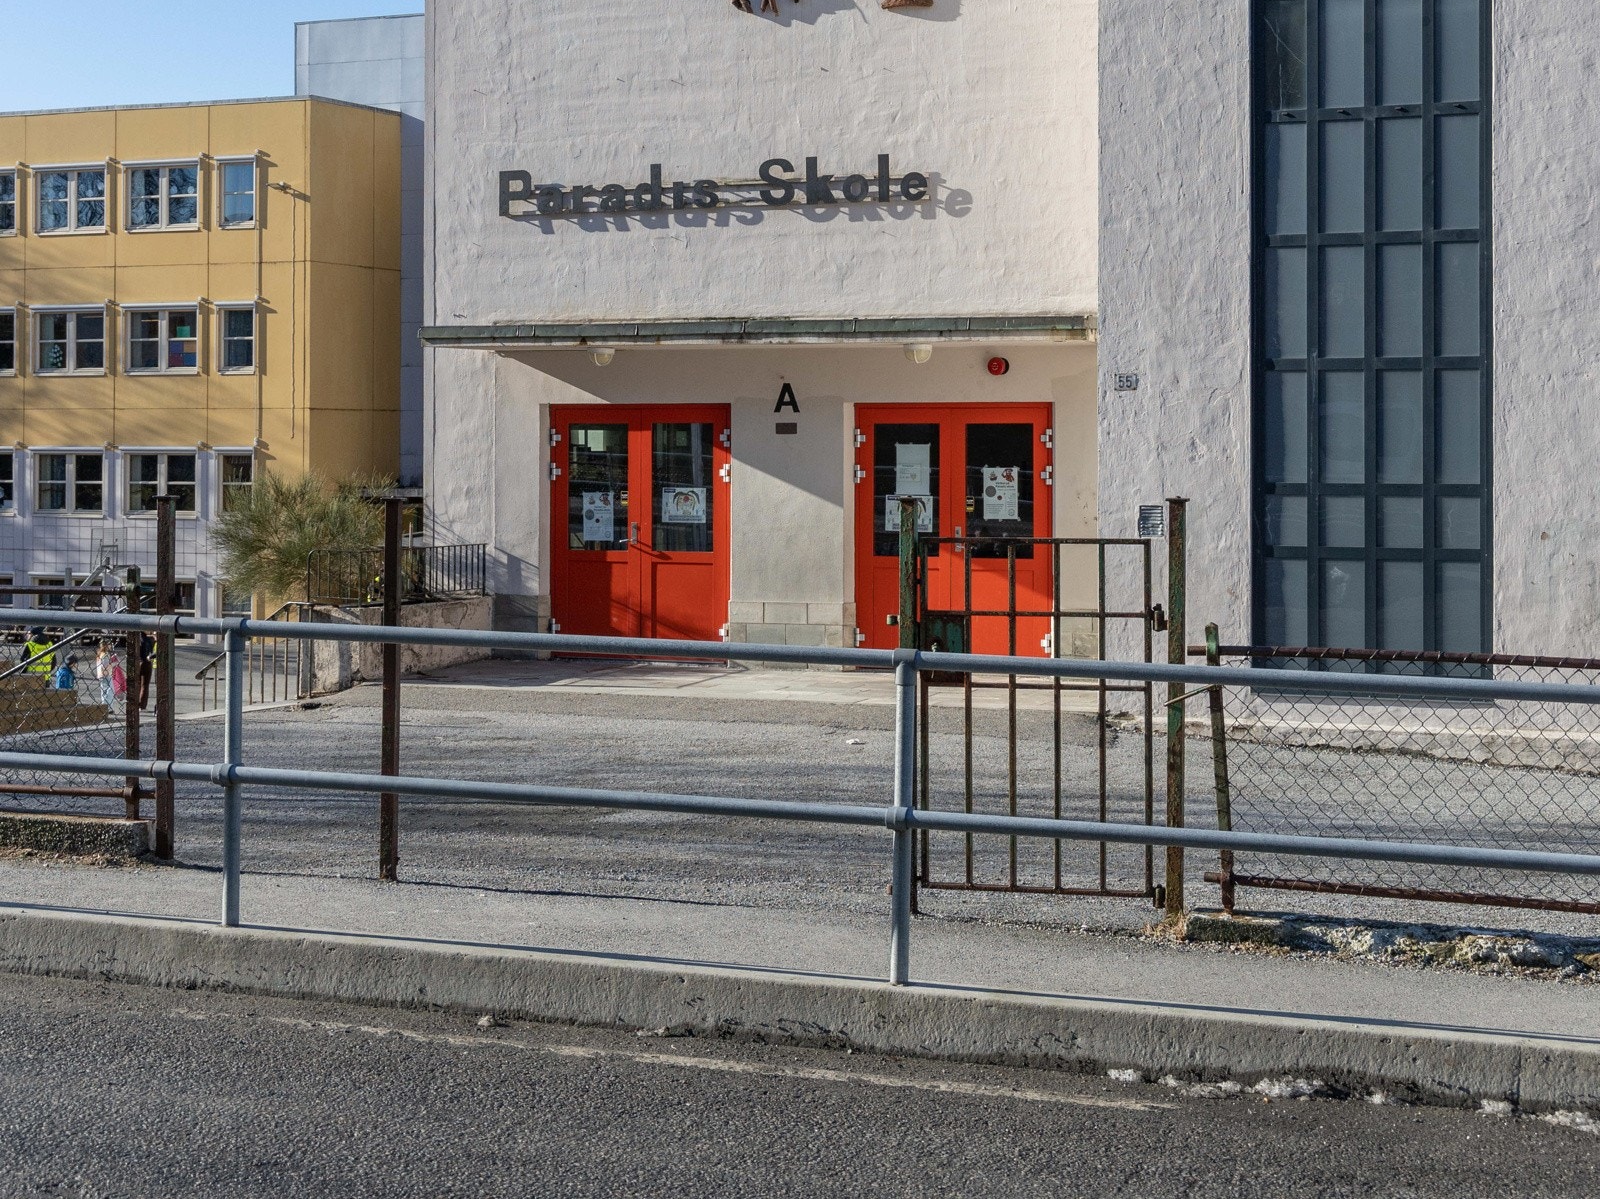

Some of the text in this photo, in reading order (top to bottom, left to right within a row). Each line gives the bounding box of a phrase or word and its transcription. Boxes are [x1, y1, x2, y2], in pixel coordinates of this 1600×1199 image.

[499, 153, 929, 217] Paradis Skole
[1118, 375, 1133, 388] 55
[773, 382, 800, 413] A
